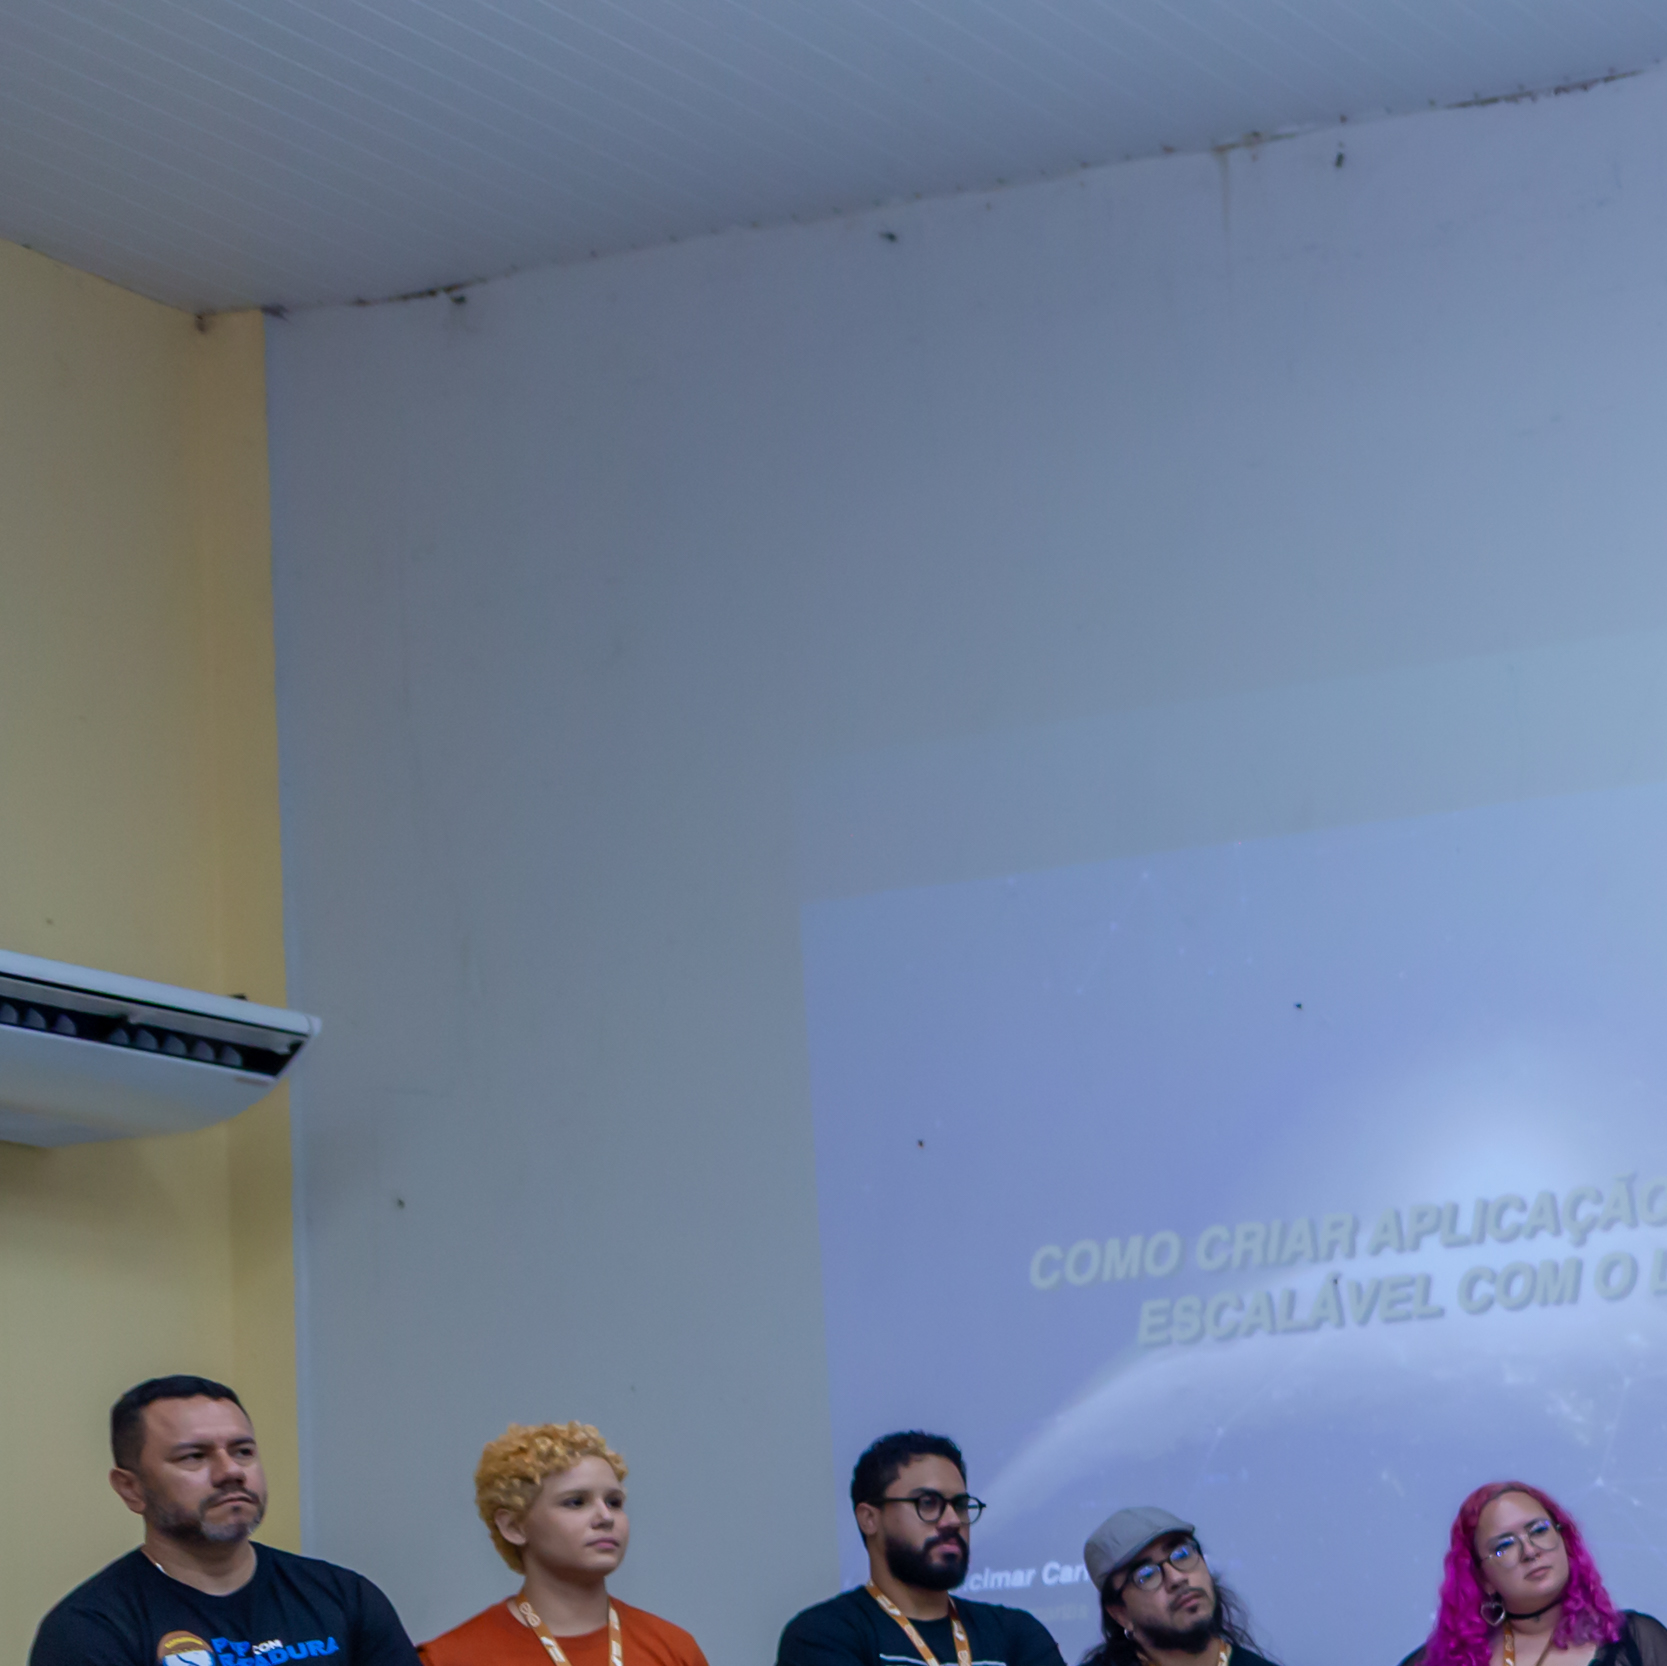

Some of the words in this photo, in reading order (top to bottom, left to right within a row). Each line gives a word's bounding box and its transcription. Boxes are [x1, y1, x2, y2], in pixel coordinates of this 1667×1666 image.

[1029, 1229, 1183, 1289] COMO
[1196, 1212, 1357, 1271] CRIAR
[1137, 1270, 1444, 1347] ESCALÁVEL
[1458, 1256, 1583, 1315] COM
[1593, 1251, 1638, 1301] O
